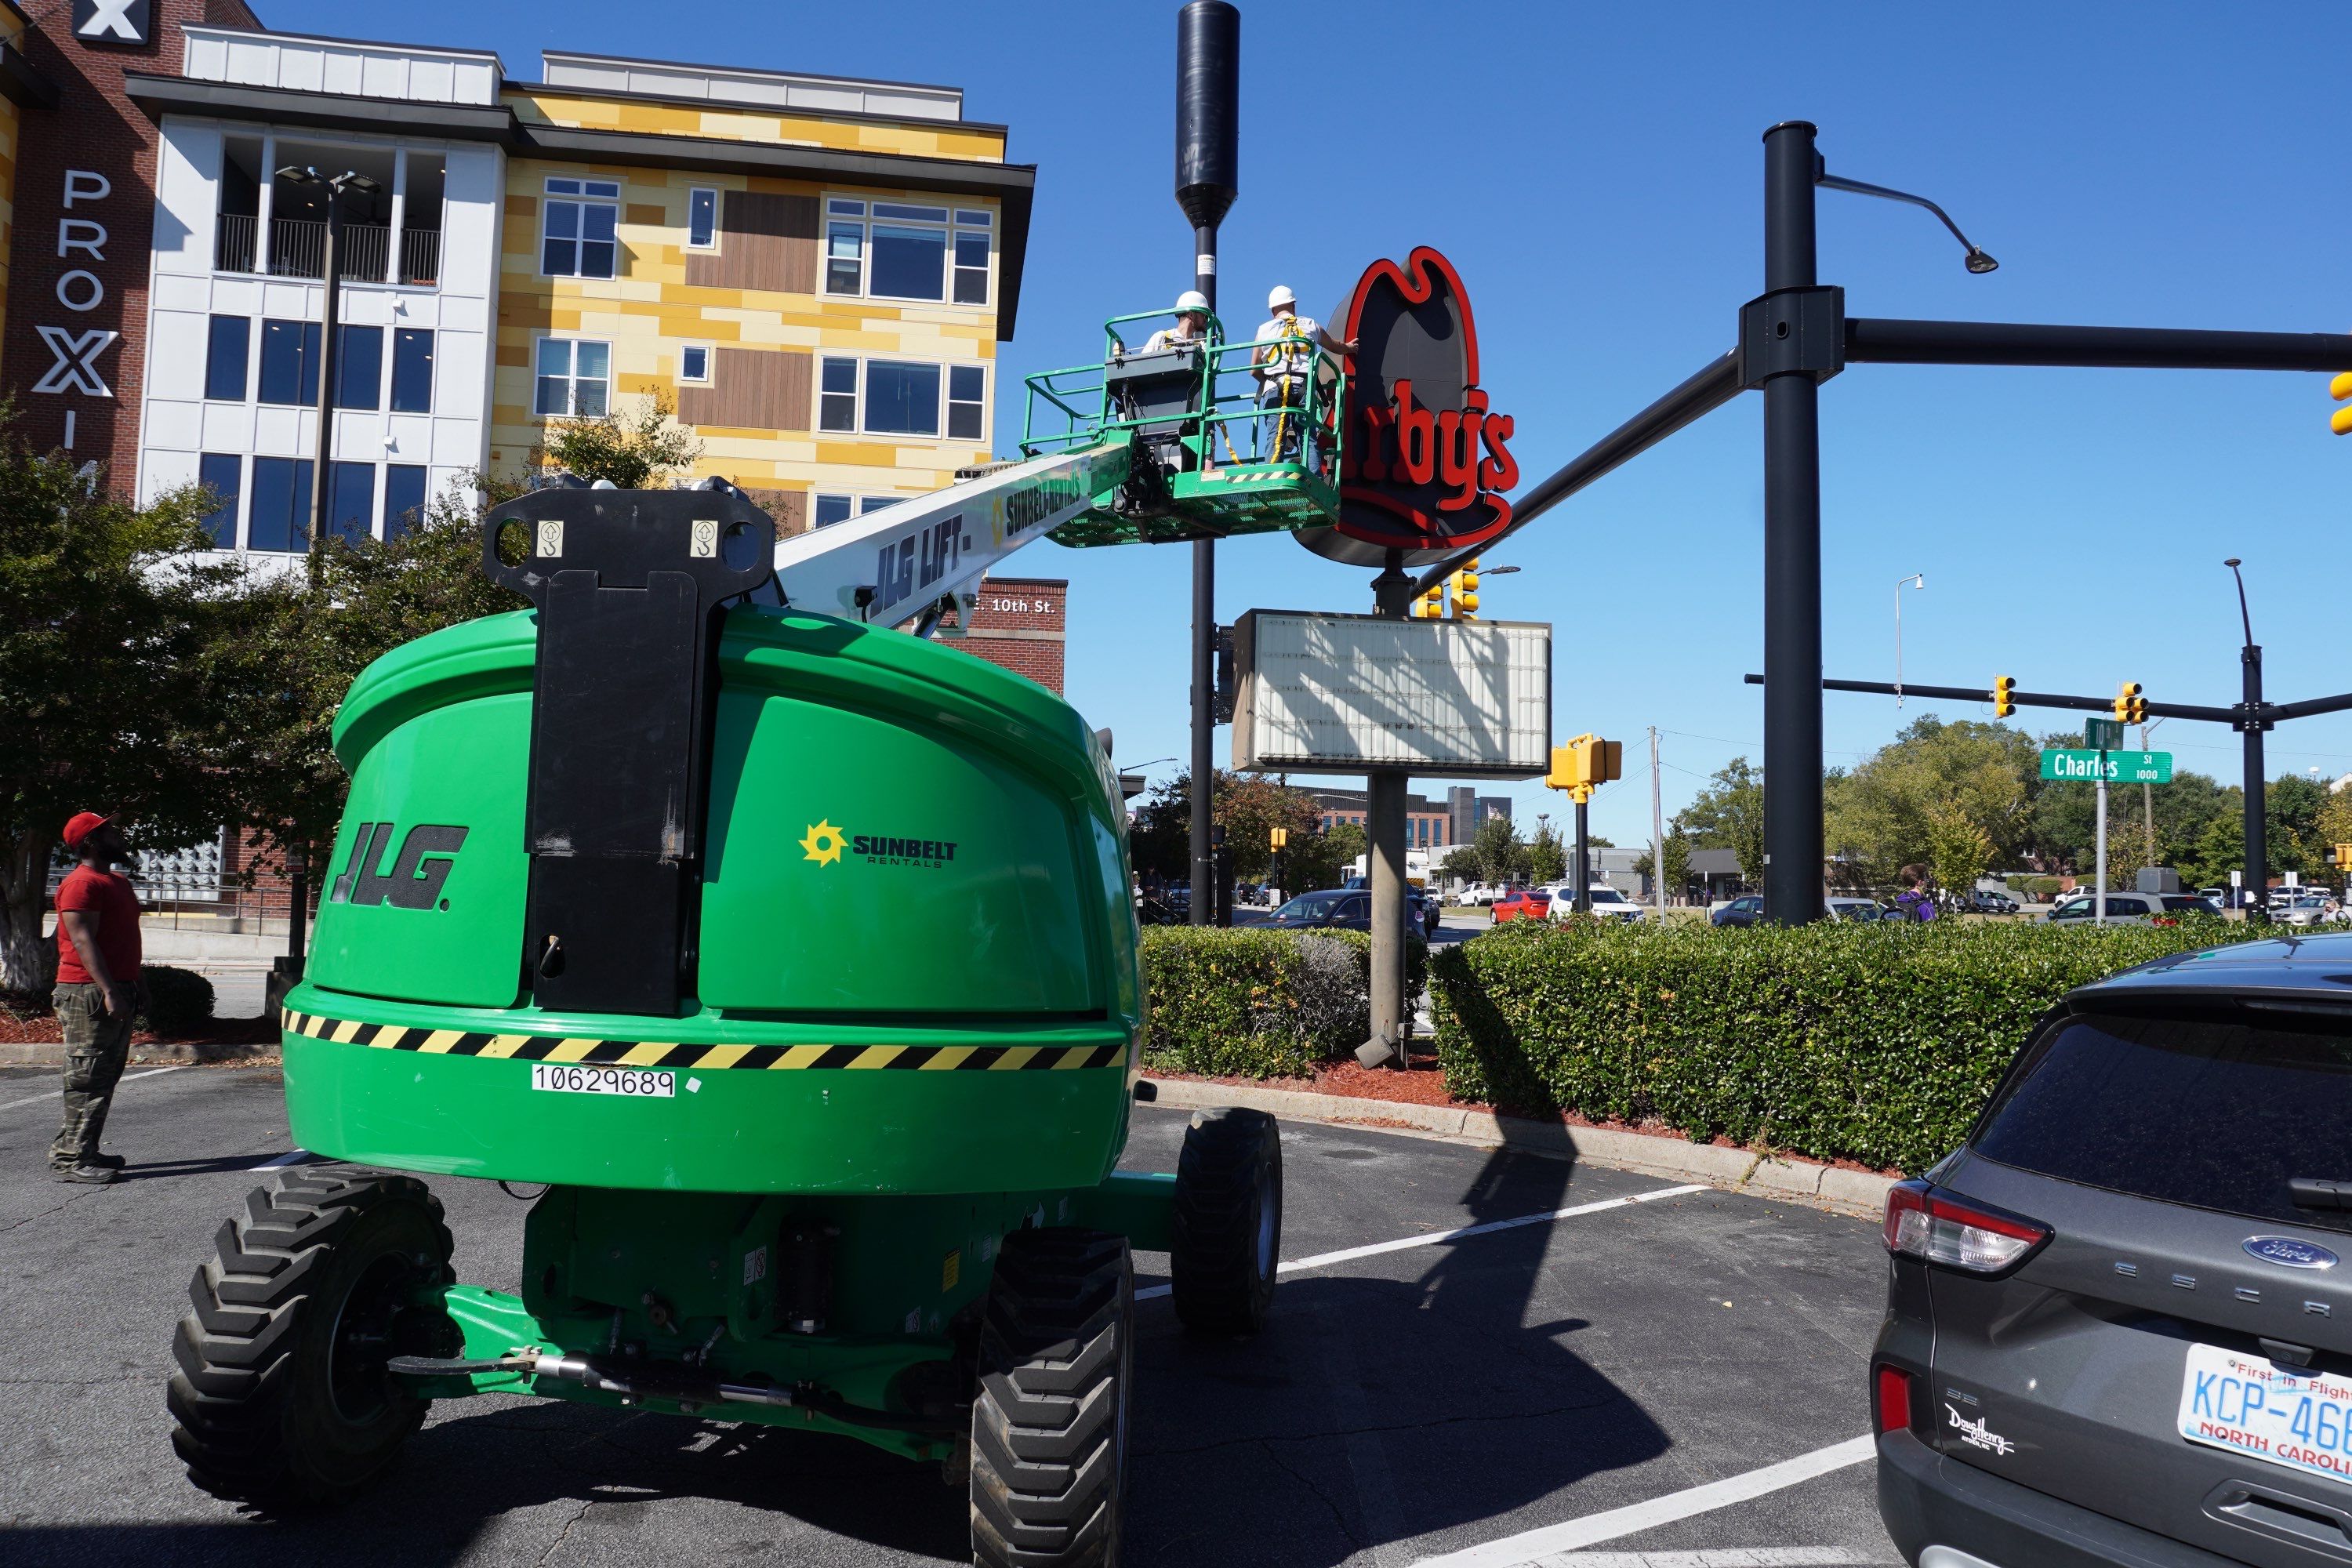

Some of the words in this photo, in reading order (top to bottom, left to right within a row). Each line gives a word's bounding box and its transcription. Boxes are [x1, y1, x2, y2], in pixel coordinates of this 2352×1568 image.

[992, 598, 1028, 612] 10th
[1034, 600, 1055, 613] St.
[2054, 753, 2118, 778] Charles
[2143, 754, 2153, 764] St
[2136, 769, 2158, 780] 1000
[852, 835, 958, 861] SUNBELT
[867, 856, 942, 869] RENTALS
[535, 1065, 674, 1095] 10629689
[2262, 1240, 2315, 1262] Ford
[2237, 1363, 2272, 1381] First
[2283, 1374, 2297, 1387] in
[2200, 1421, 2269, 1452] NORTH
[2277, 1443, 2352, 1475] CAROLI
